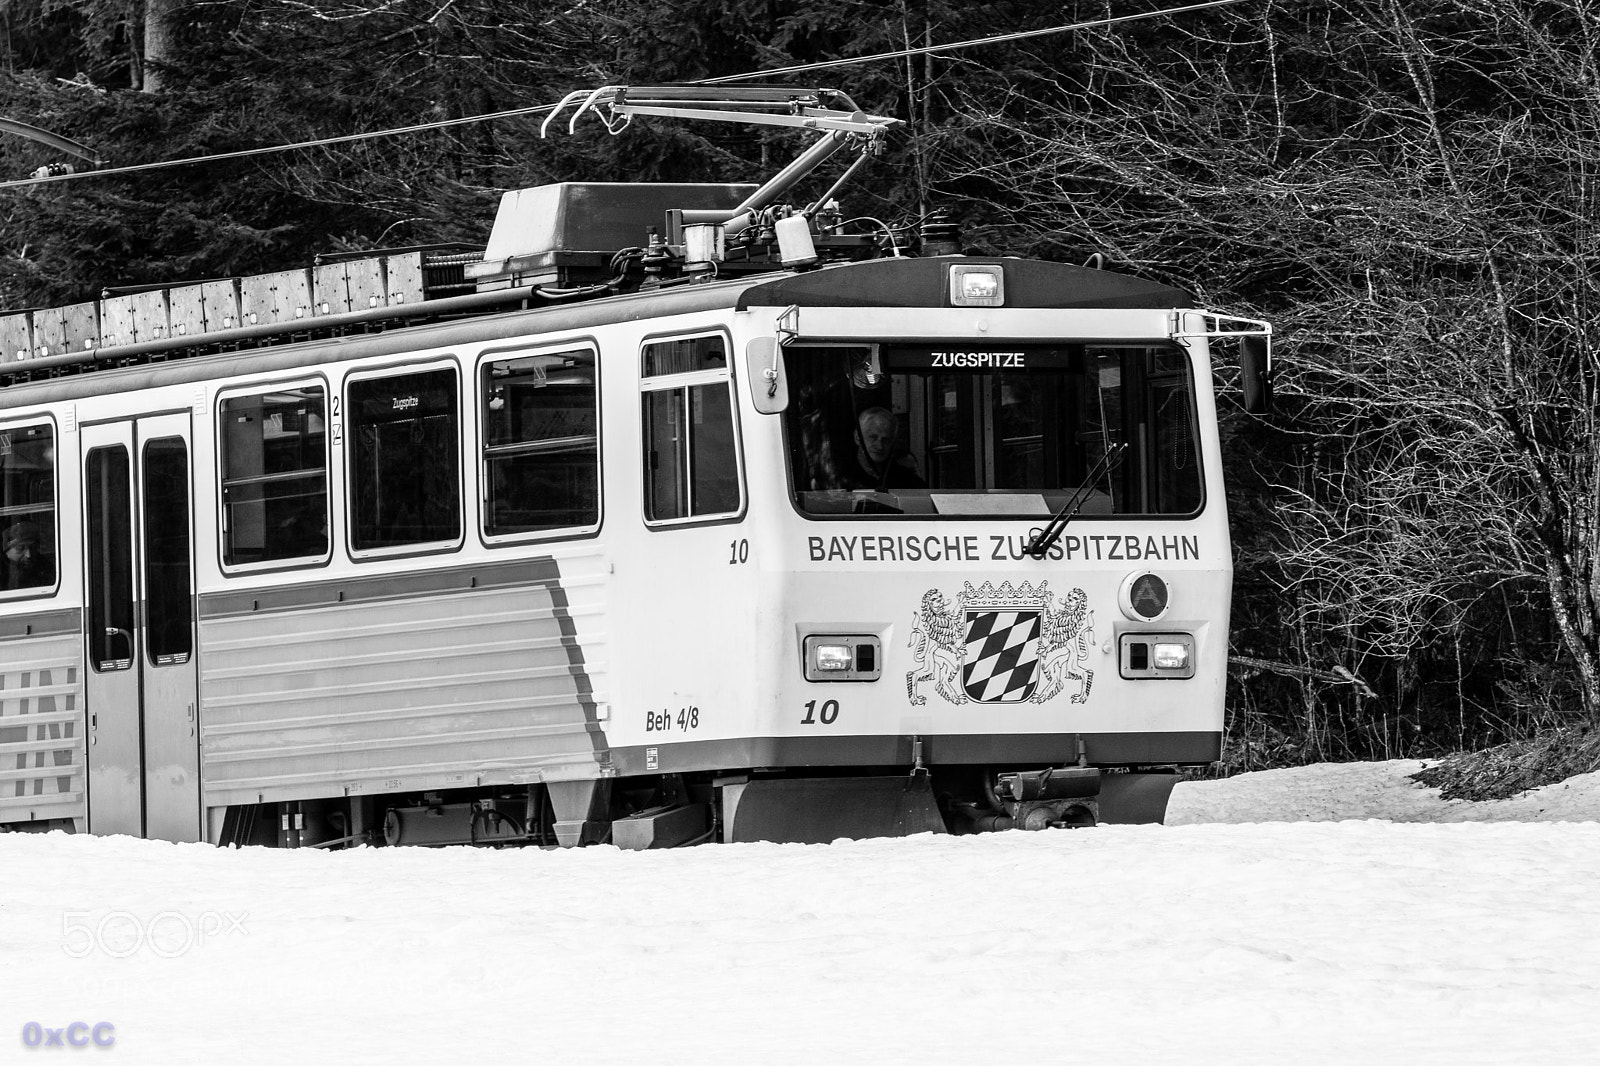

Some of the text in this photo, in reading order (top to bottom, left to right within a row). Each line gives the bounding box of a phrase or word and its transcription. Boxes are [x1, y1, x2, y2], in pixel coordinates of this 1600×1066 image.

[931, 352, 1025, 368] ZUGSPITZE
[332, 395, 340, 417] 2
[392, 396, 419, 410] Zugspitze
[729, 538, 749, 565] 10
[808, 535, 980, 562] BAYERISCHE
[1133, 577, 1163, 608] A
[646, 706, 699, 733] Beh 4/8
[800, 699, 840, 725] 10
